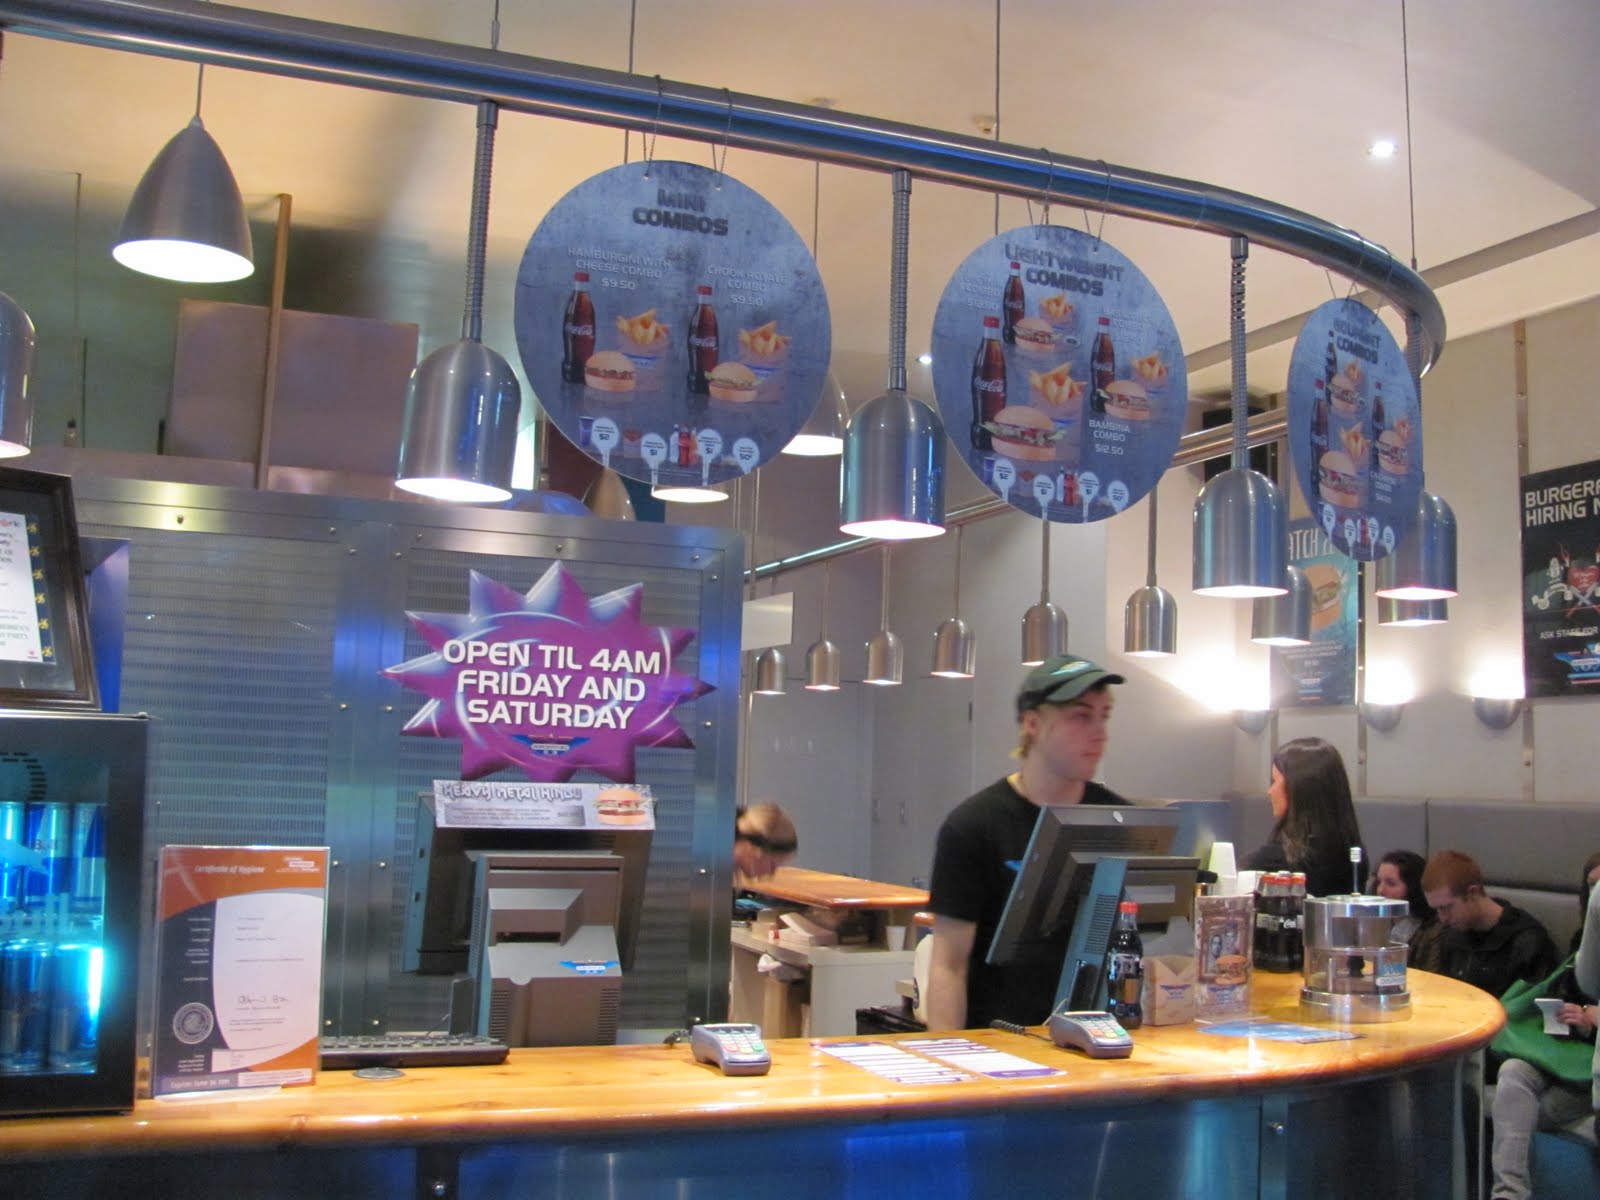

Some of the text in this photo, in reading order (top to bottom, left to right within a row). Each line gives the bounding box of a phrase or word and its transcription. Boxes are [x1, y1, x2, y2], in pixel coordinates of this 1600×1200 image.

[657, 188, 706, 212] MINI
[632, 207, 728, 236] COMBOS
[576, 259, 662, 279] CHEESE COMBO
[1005, 243, 1124, 281] LIGHTWEIGHT
[602, 278, 636, 290] $9.50
[728, 280, 768, 292] COMBO
[1026, 267, 1104, 296] COMBOS
[1089, 419, 1130, 433] BAMBINA
[1093, 430, 1126, 442] COMBO
[1095, 443, 1124, 456] $12.50
[1526, 500, 1587, 527] HIRING
[1540, 630, 1554, 640] ASK
[443, 639, 661, 675] OPEN TIL 4AM
[458, 670, 646, 702] FRIDAY AND
[467, 699, 635, 730] SATURDAY
[442, 785, 492, 801] HEAVY
[496, 787, 537, 802] METAL
